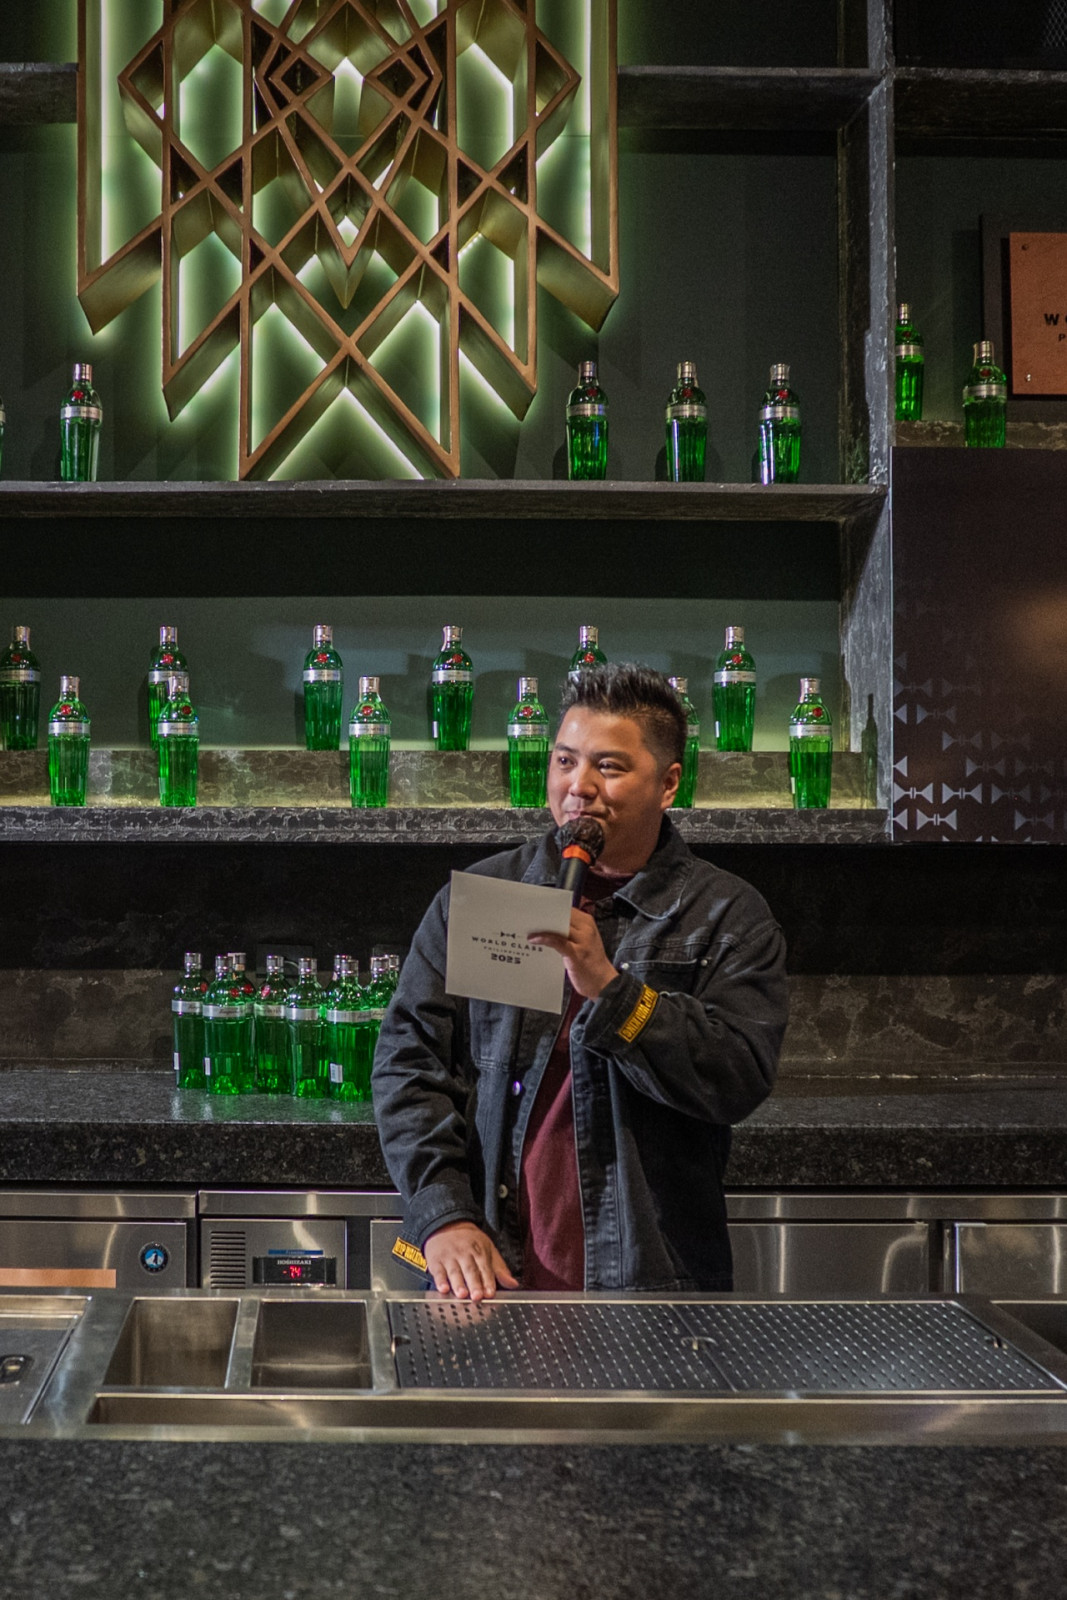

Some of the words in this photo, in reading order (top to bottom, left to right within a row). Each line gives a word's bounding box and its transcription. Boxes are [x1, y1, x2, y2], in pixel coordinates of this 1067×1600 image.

[1043, 313, 1067, 326] W
[472, 936, 507, 946] WORLD
[510, 942, 543, 952] CLASS
[490, 952, 521, 964] 2025
[622, 1003, 651, 1038] WALKING
